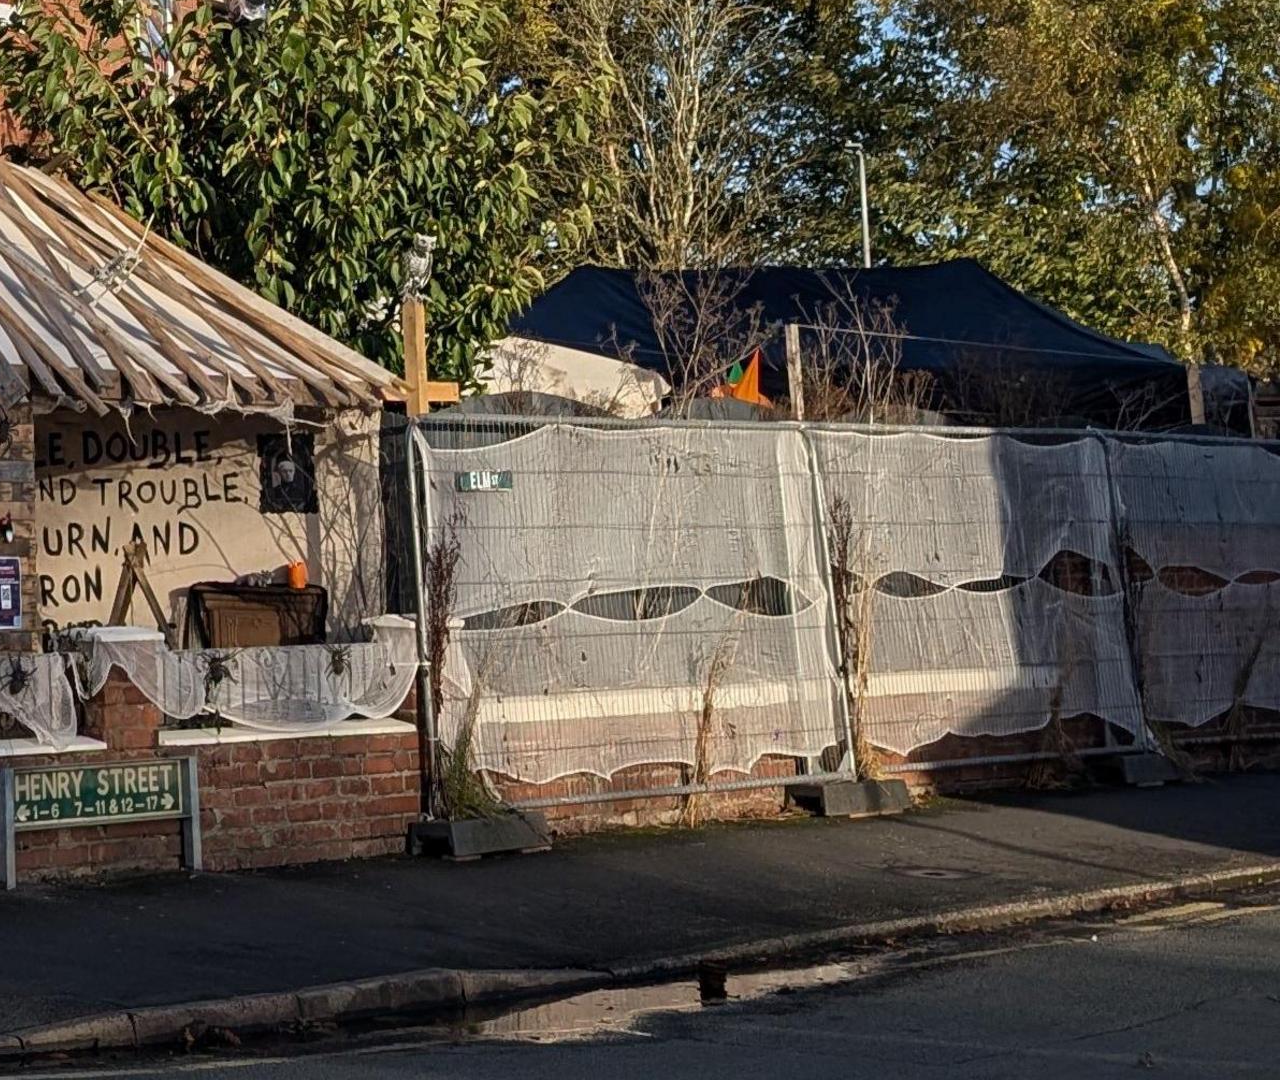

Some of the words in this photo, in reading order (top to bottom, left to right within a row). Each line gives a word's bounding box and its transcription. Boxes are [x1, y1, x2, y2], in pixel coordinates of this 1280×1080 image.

[470, 471, 490, 489] ELM
[15, 770, 84, 802] HENRY
[97, 765, 173, 796] STREET
[109, 800, 118, 814] &
